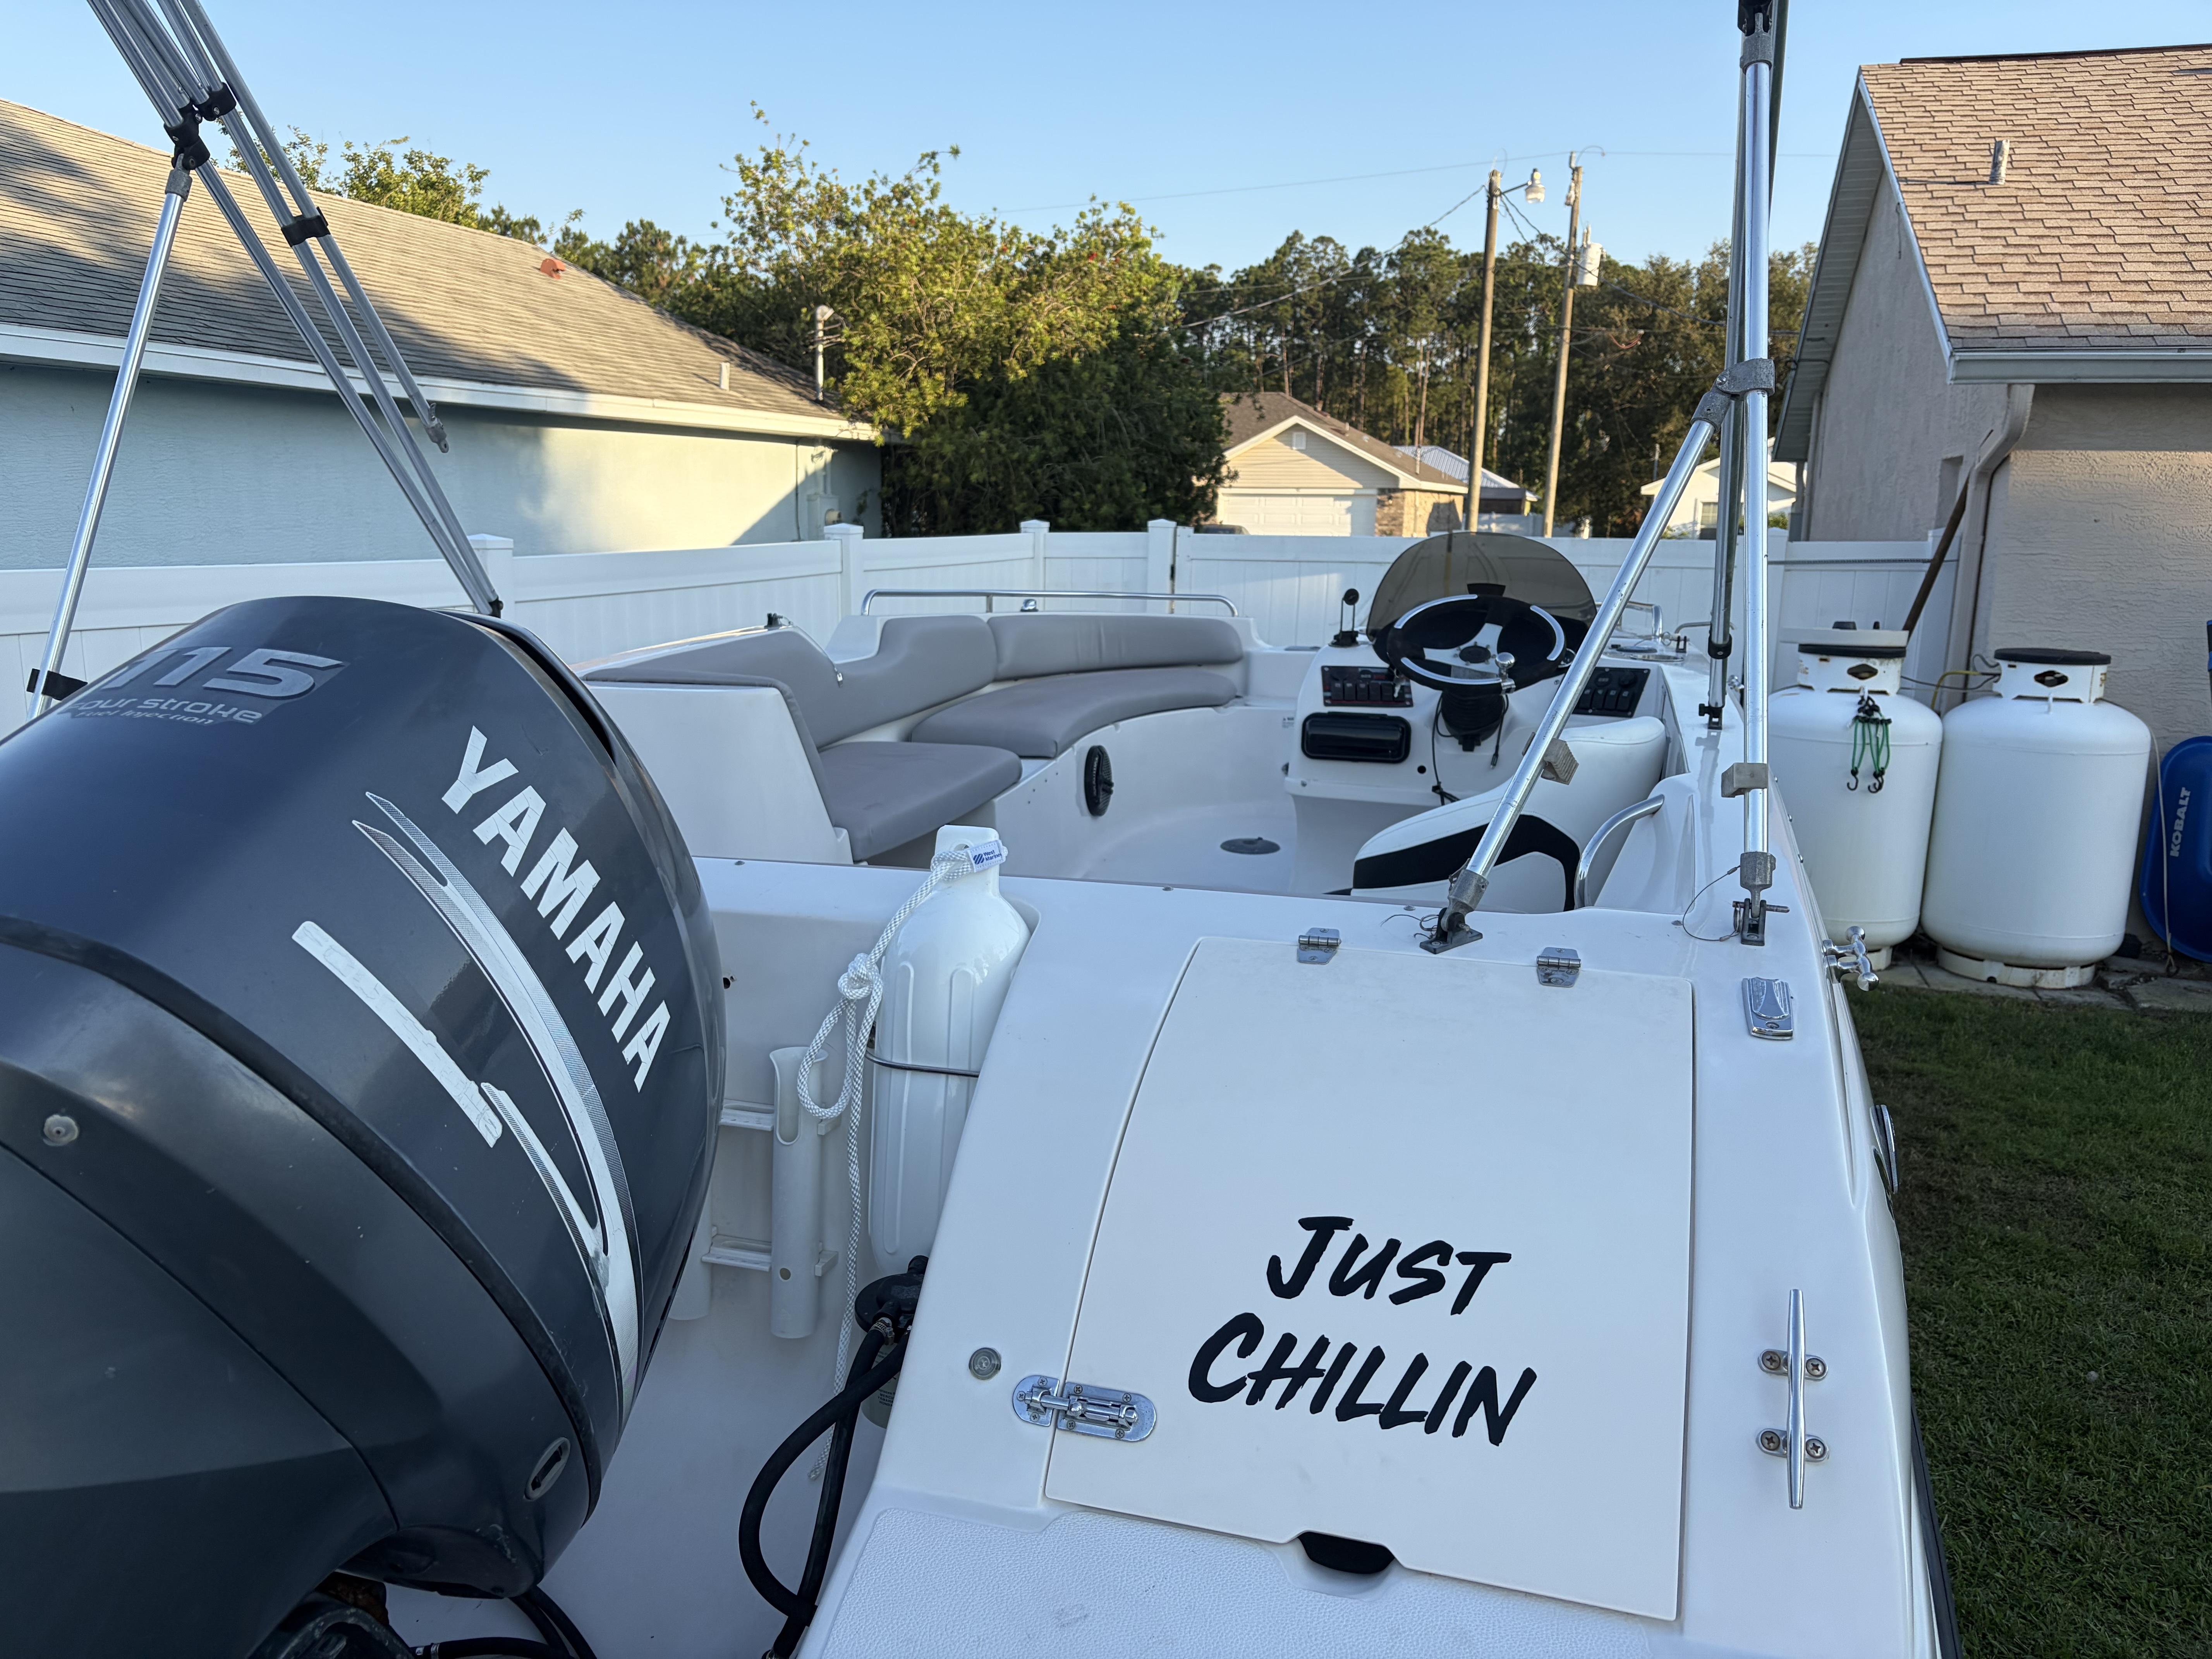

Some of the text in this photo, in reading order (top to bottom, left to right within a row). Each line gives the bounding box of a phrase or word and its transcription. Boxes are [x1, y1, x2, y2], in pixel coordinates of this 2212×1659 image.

[137, 698, 262, 723] stroke
[2170, 787, 2191, 857] KOBALT
[441, 725, 670, 1092] YAMAHA
[1266, 1216, 1512, 1316] JUST
[1188, 1312, 1537, 1446] CHILLIN
